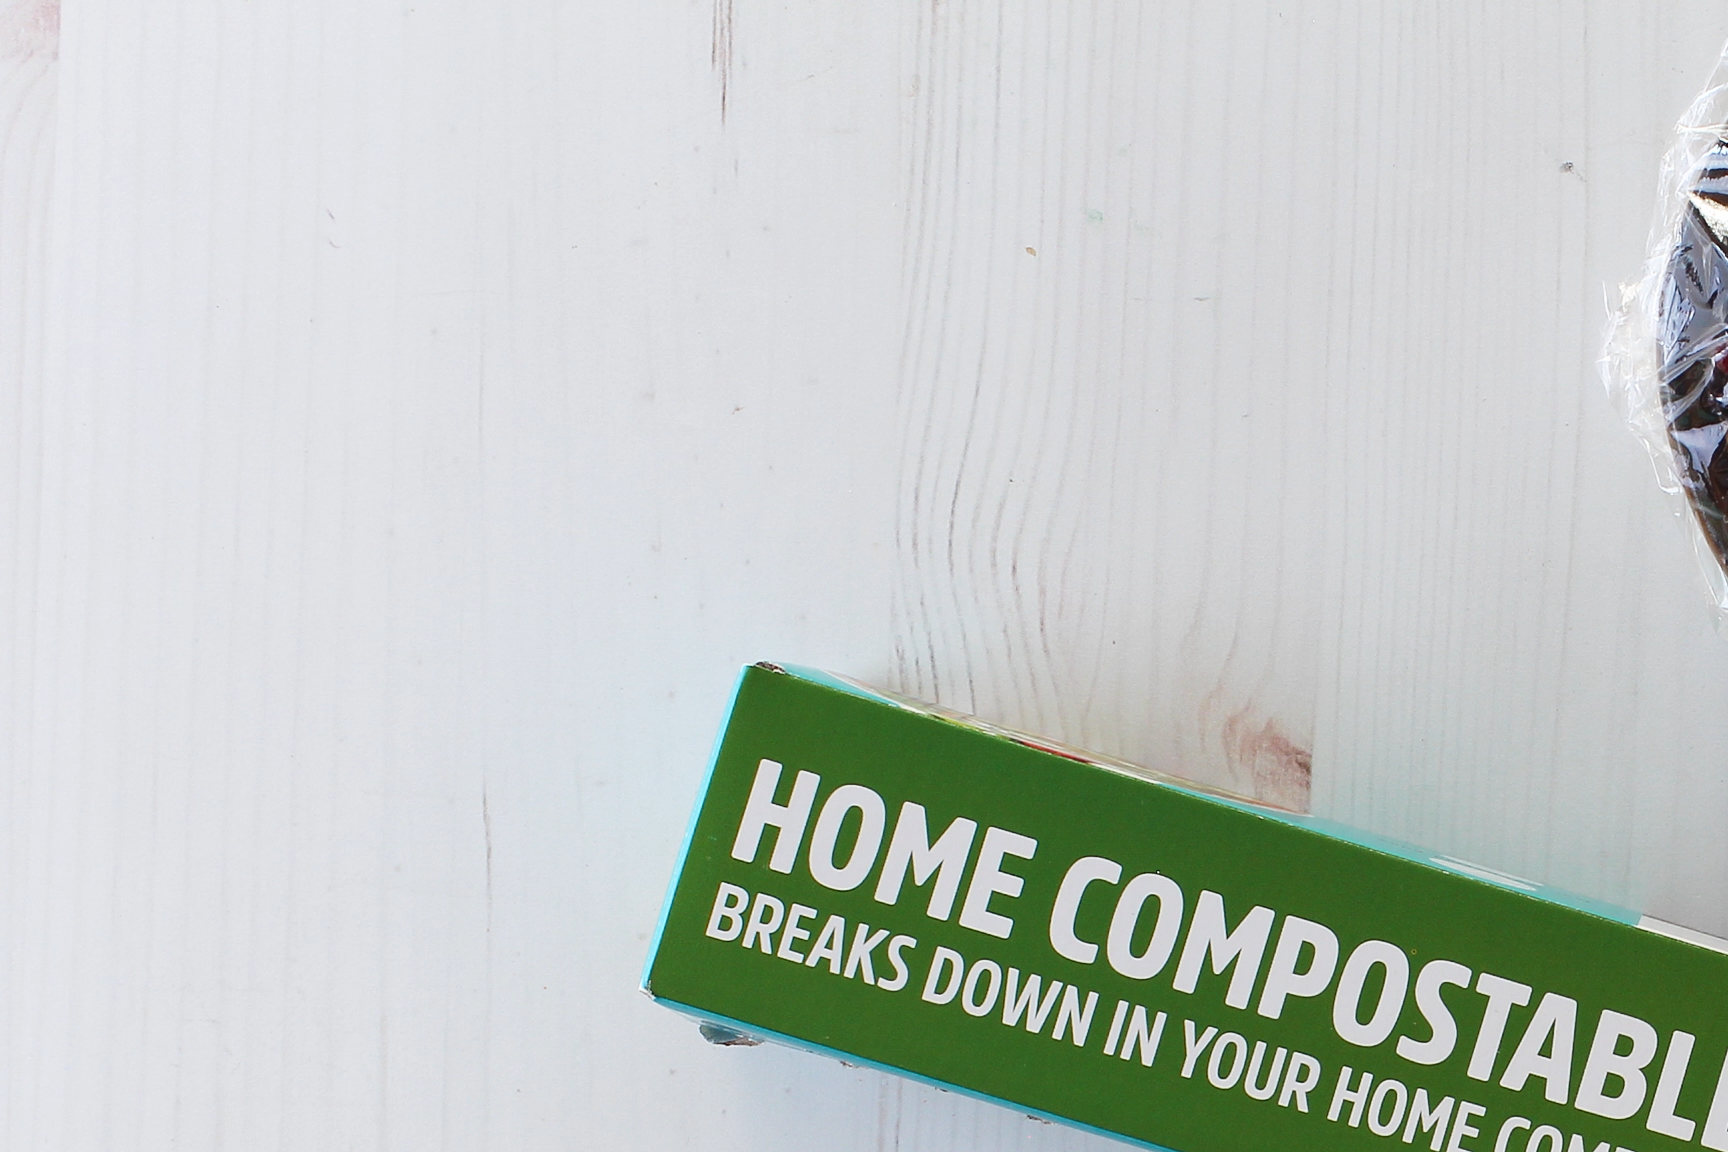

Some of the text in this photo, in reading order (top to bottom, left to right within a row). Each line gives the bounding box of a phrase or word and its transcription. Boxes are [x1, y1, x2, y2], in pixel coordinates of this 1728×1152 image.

[731, 758, 1038, 939] HOME
[705, 881, 918, 992] BREAKS
[921, 945, 1100, 1047] DOWN
[1103, 999, 1168, 1067] IN
[1180, 1019, 1321, 1113] YOUR
